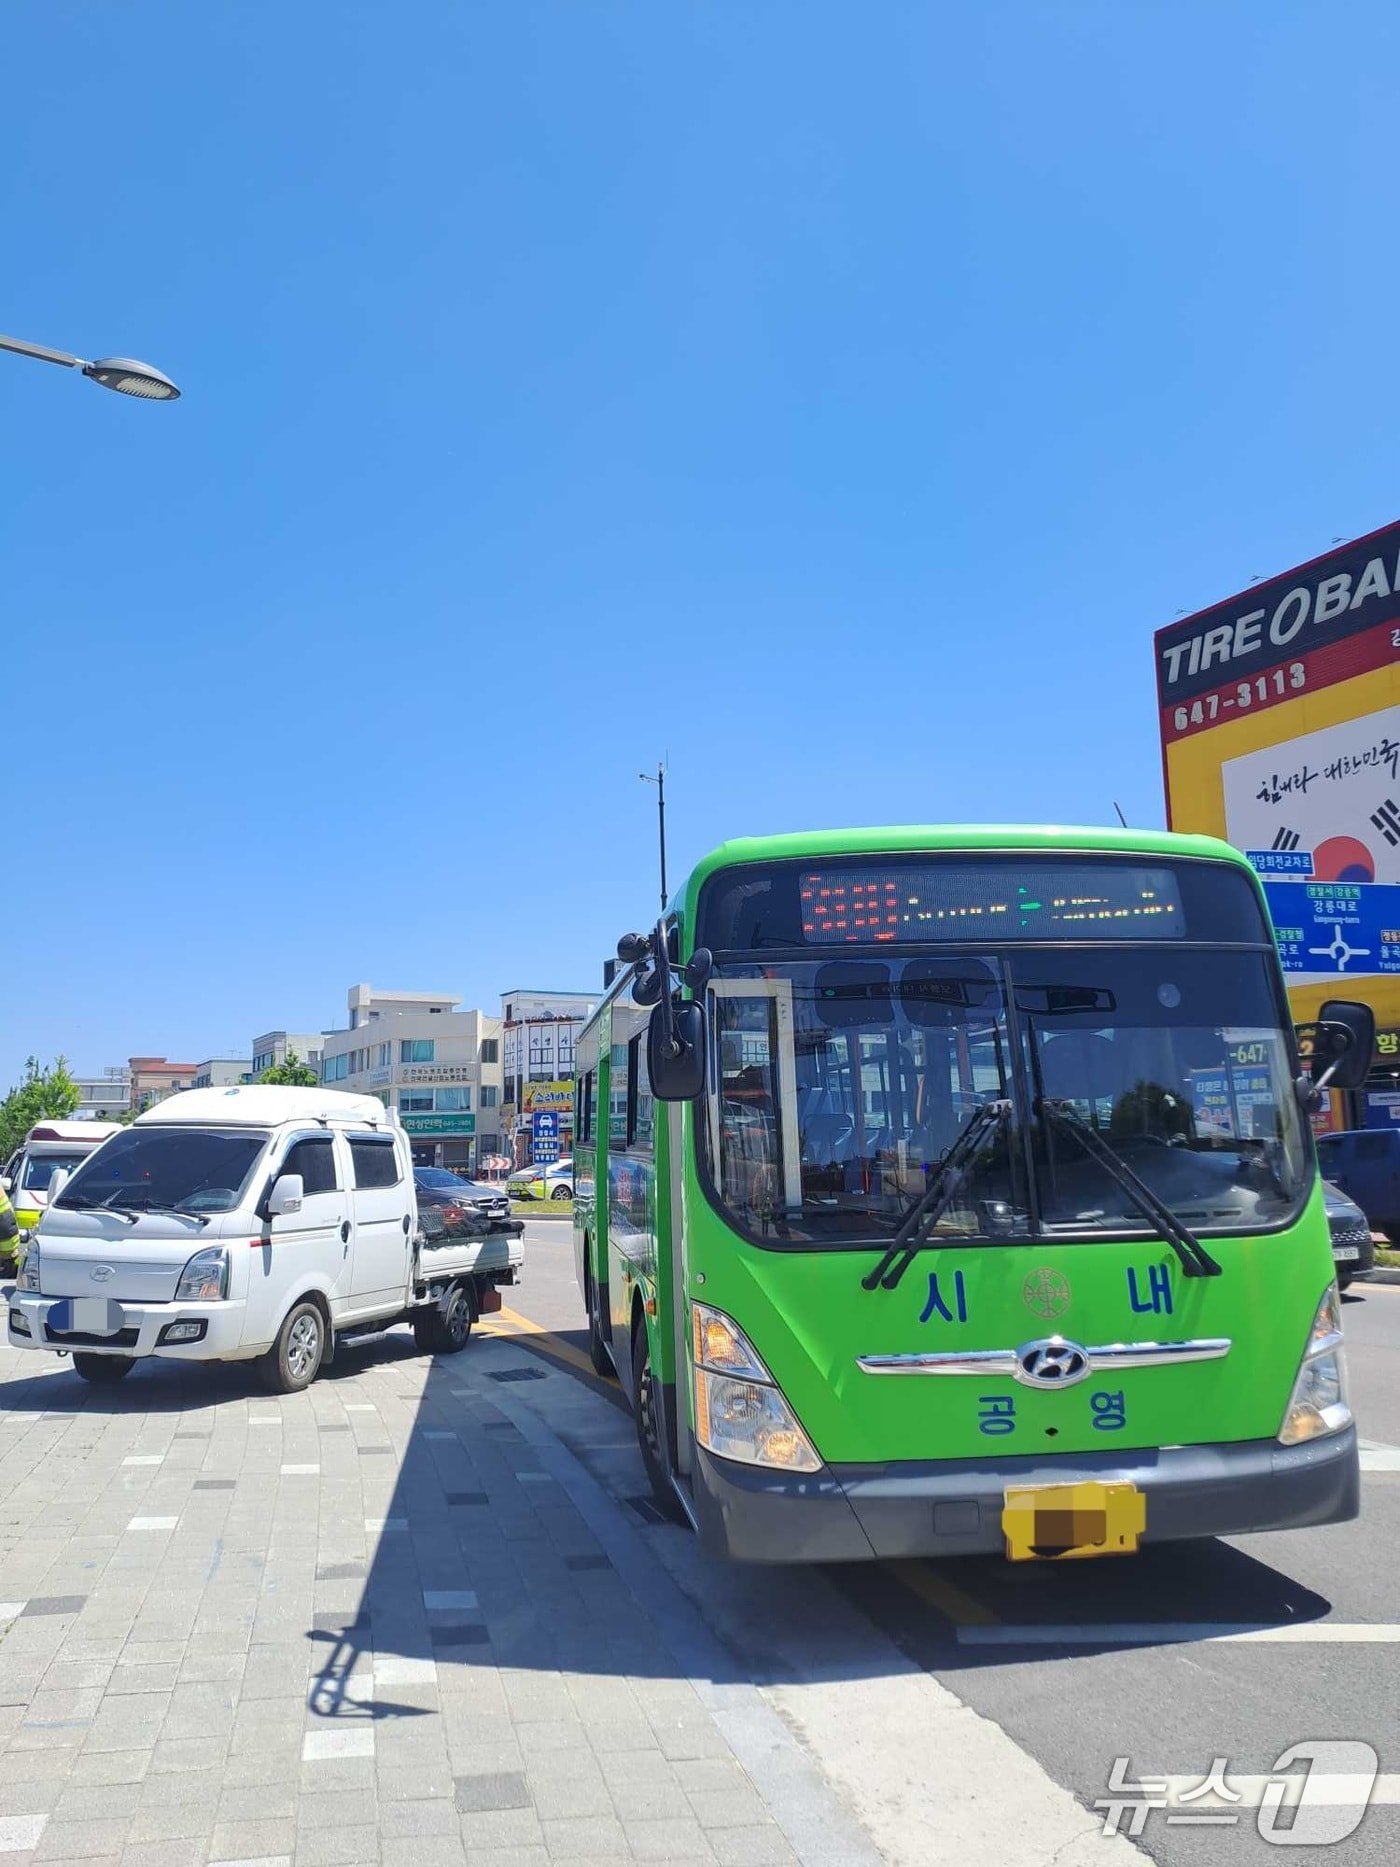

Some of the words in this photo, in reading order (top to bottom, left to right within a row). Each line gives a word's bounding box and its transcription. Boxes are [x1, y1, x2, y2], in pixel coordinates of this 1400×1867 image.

[1174, 662, 1305, 731] 647-3113
[1256, 766, 1319, 804] 힘내라
[1324, 739, 1400, 779] 대한민국
[1313, 900, 1358, 913] 강릉대로
[1376, 1033, 1399, 1054] 항
[919, 1269, 967, 1323] 시
[1127, 1263, 1173, 1315] 내
[977, 1395, 1017, 1436] 공
[1090, 1390, 1127, 1431] 영
